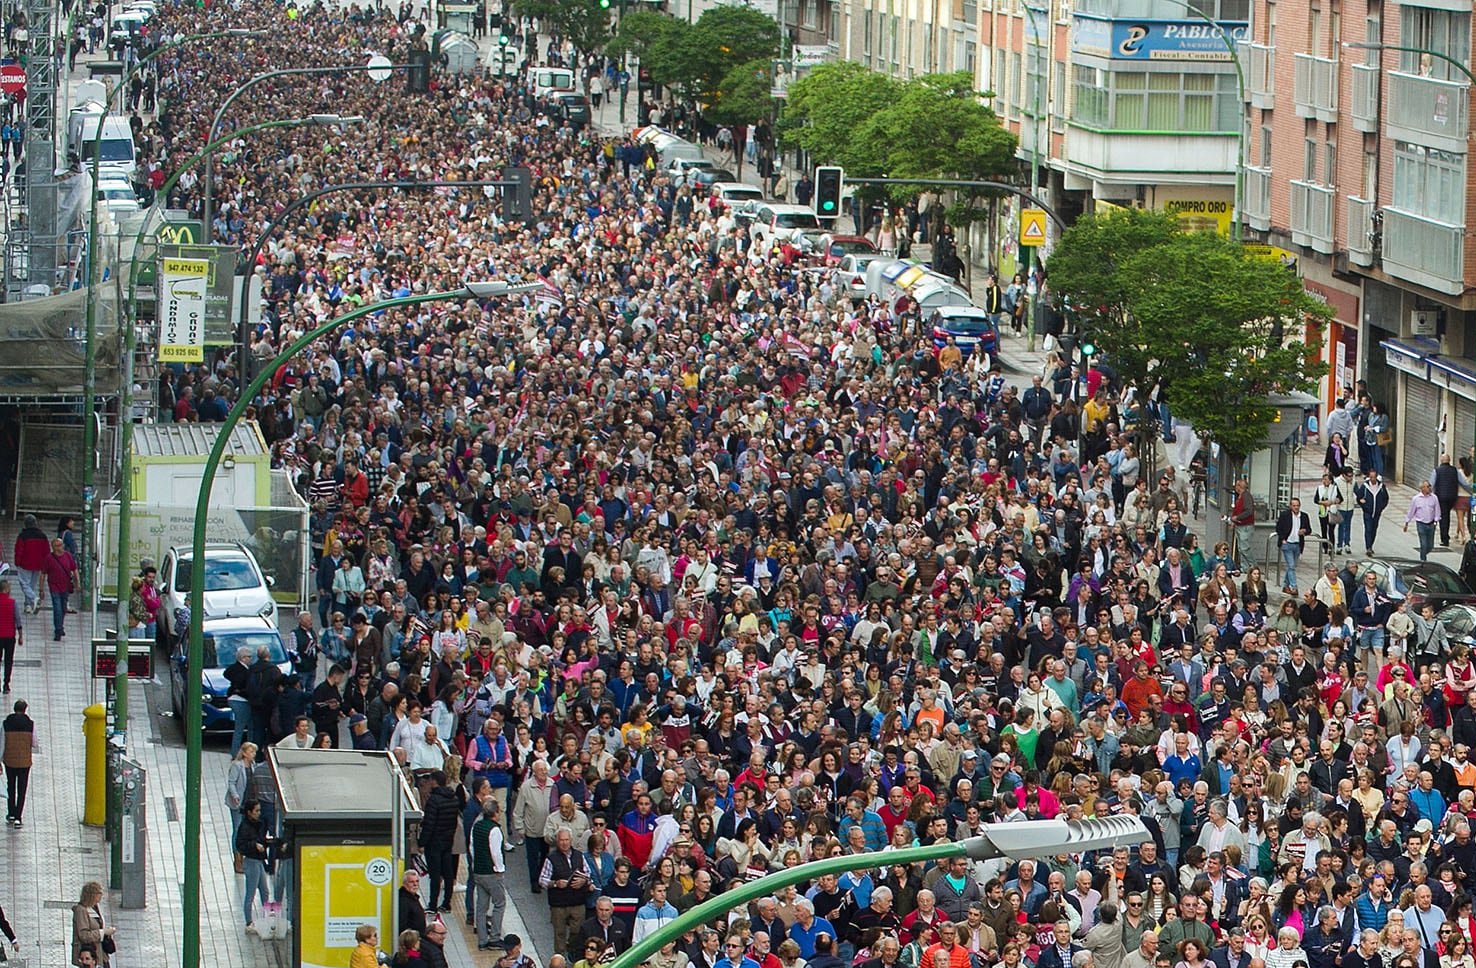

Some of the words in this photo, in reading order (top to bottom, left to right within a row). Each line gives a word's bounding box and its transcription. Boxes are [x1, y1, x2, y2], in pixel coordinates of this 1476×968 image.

[1163, 24, 1224, 39] PABLO
[1168, 200, 1205, 213] COMPRO
[1208, 200, 1227, 214] ORO
[372, 865, 386, 874] 20
